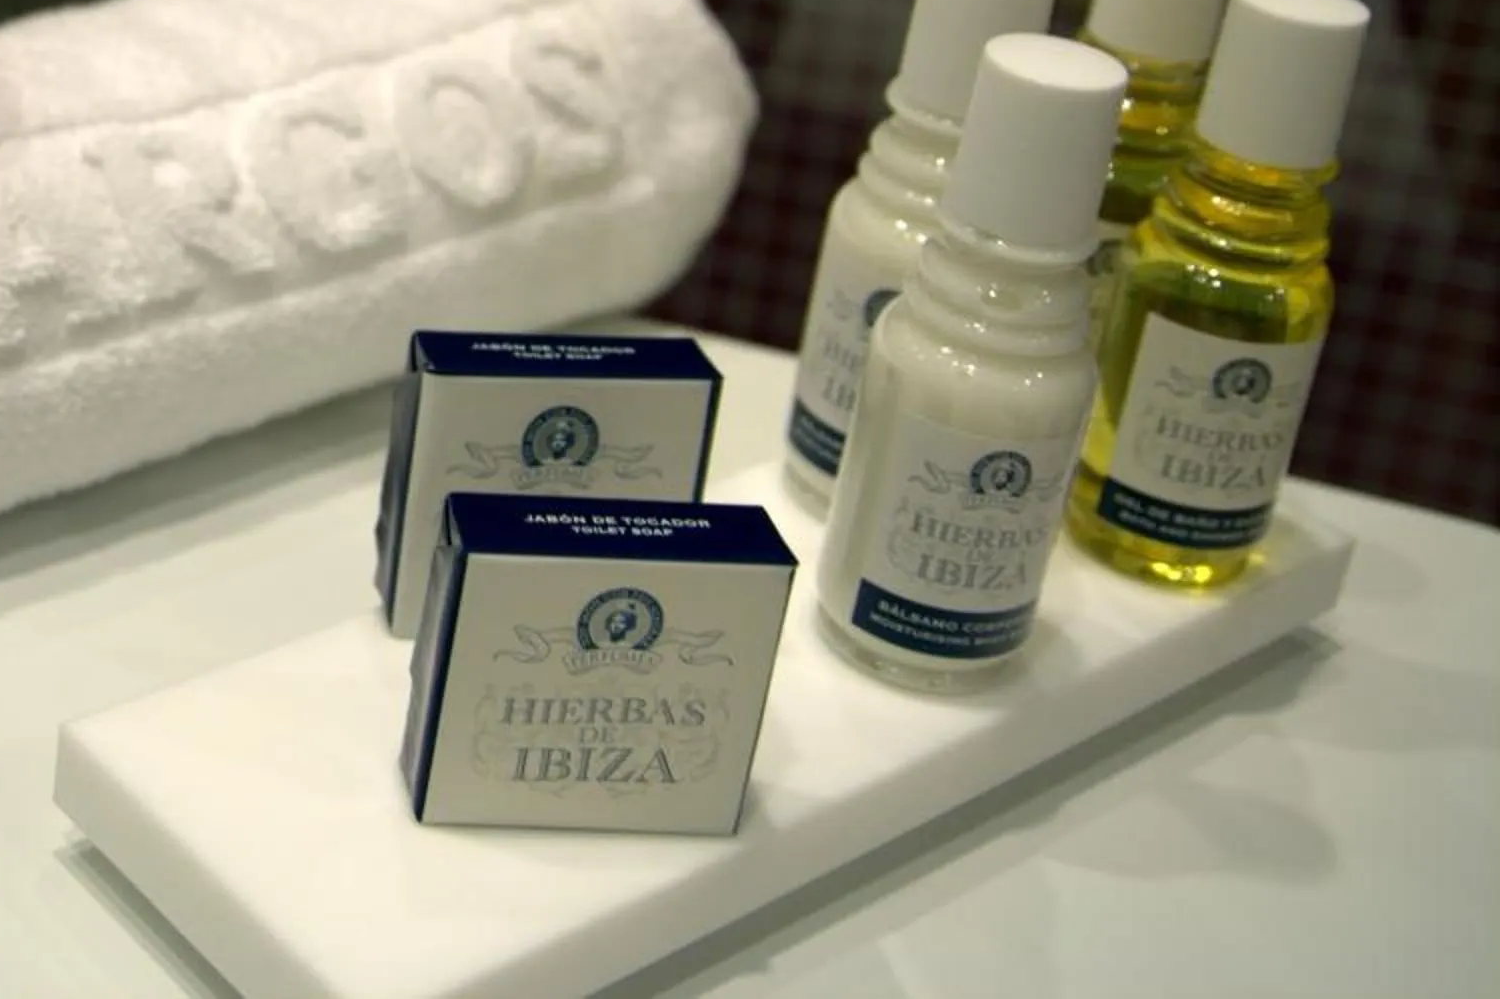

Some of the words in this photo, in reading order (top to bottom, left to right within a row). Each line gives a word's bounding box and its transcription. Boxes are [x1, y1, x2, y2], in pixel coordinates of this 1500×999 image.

[524, 512, 586, 524] JABÓN
[591, 514, 617, 525] DE
[620, 515, 712, 530] TOCADOR
[571, 525, 626, 536] TOILET
[631, 526, 673, 537] SOAP
[917, 552, 1028, 591] IBIZA
[499, 696, 708, 727] HIERBAS
[578, 726, 619, 744] DE
[511, 745, 680, 785] IBIZA
